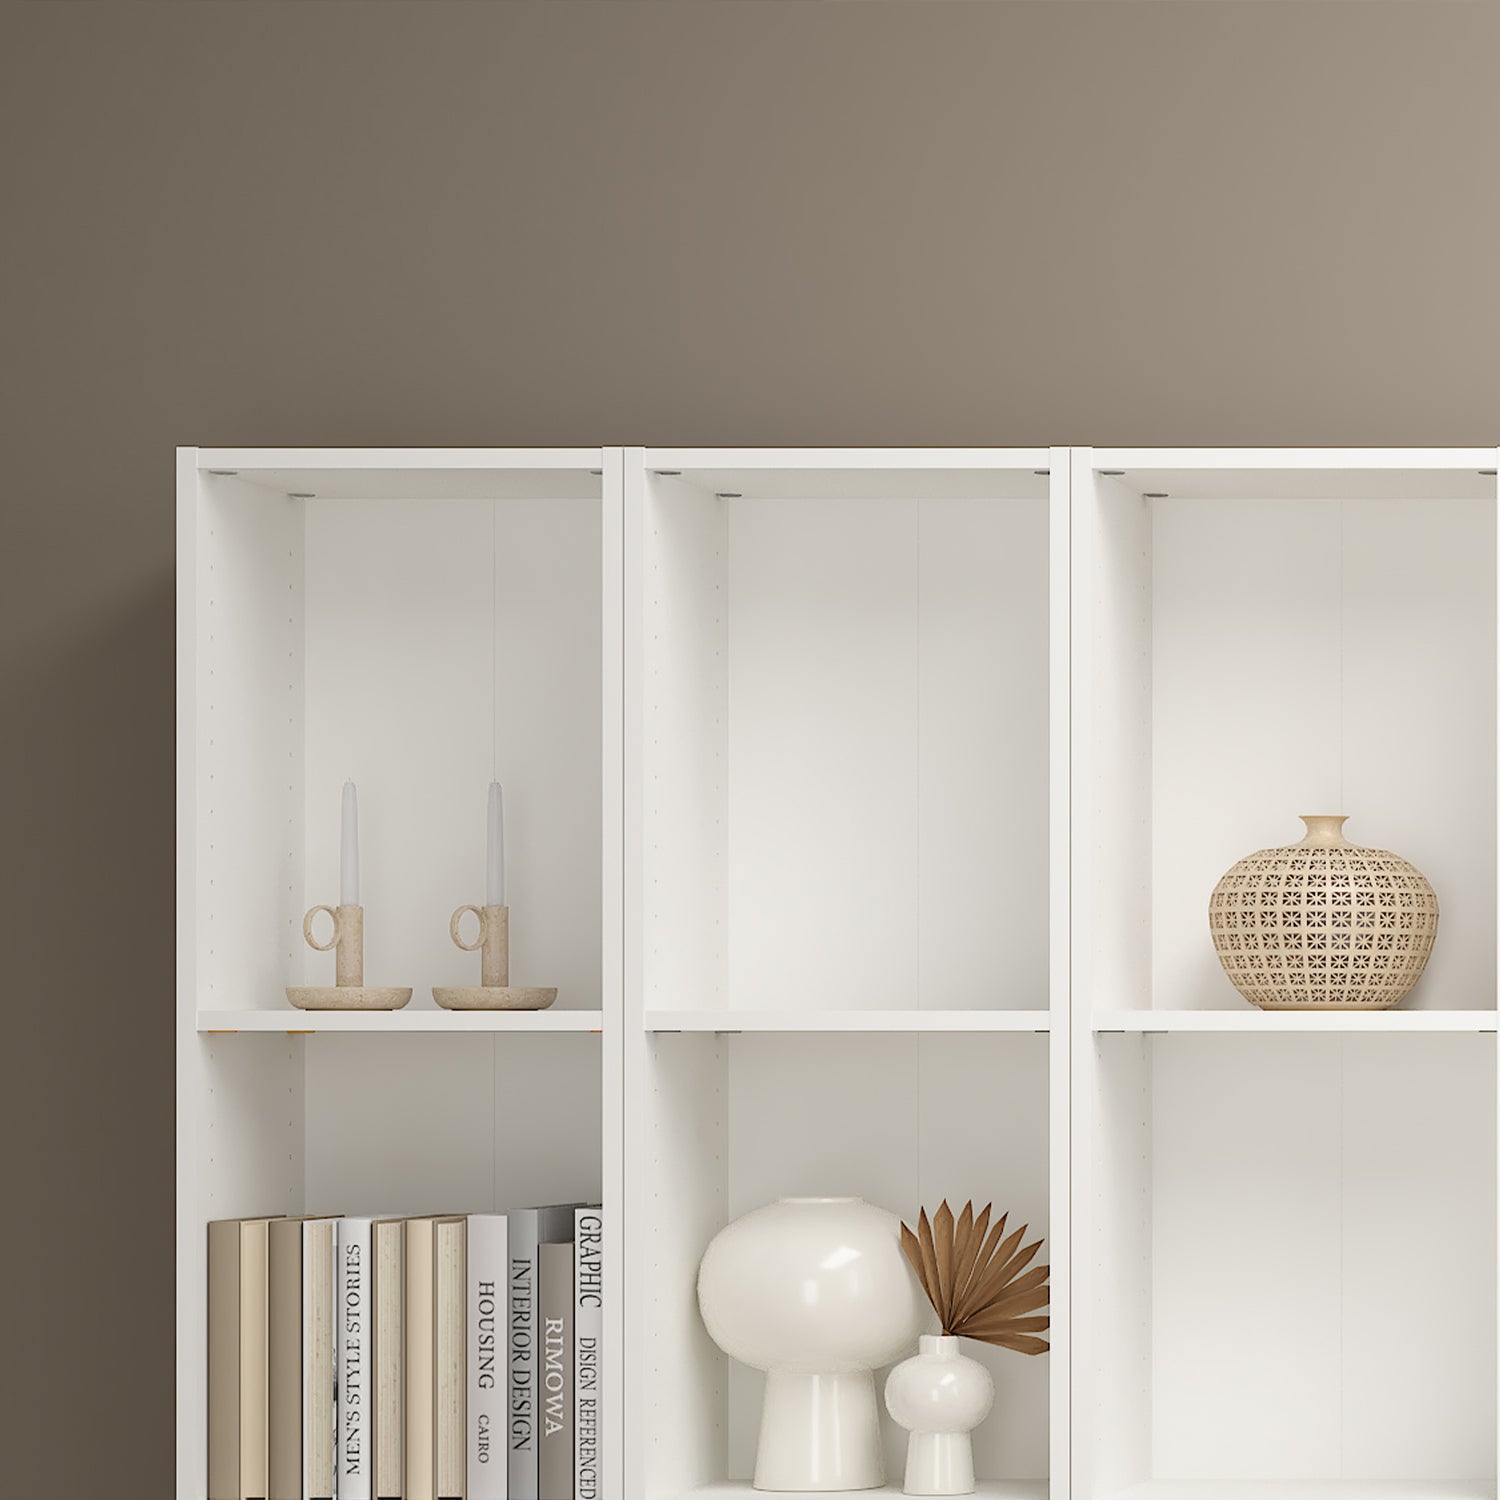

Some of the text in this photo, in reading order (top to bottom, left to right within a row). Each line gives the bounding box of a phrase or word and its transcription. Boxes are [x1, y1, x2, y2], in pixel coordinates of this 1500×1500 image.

[345, 1244, 361, 1475] MEN'S STYLE STORIES
[478, 1281, 495, 1464] HOUSING CAIRO
[512, 1259, 531, 1451] INTERIOR DESIGN
[545, 1317, 564, 1436] RIMOWA
[579, 1216, 602, 1500] GRAPHIC DISIGN REFERENCED
